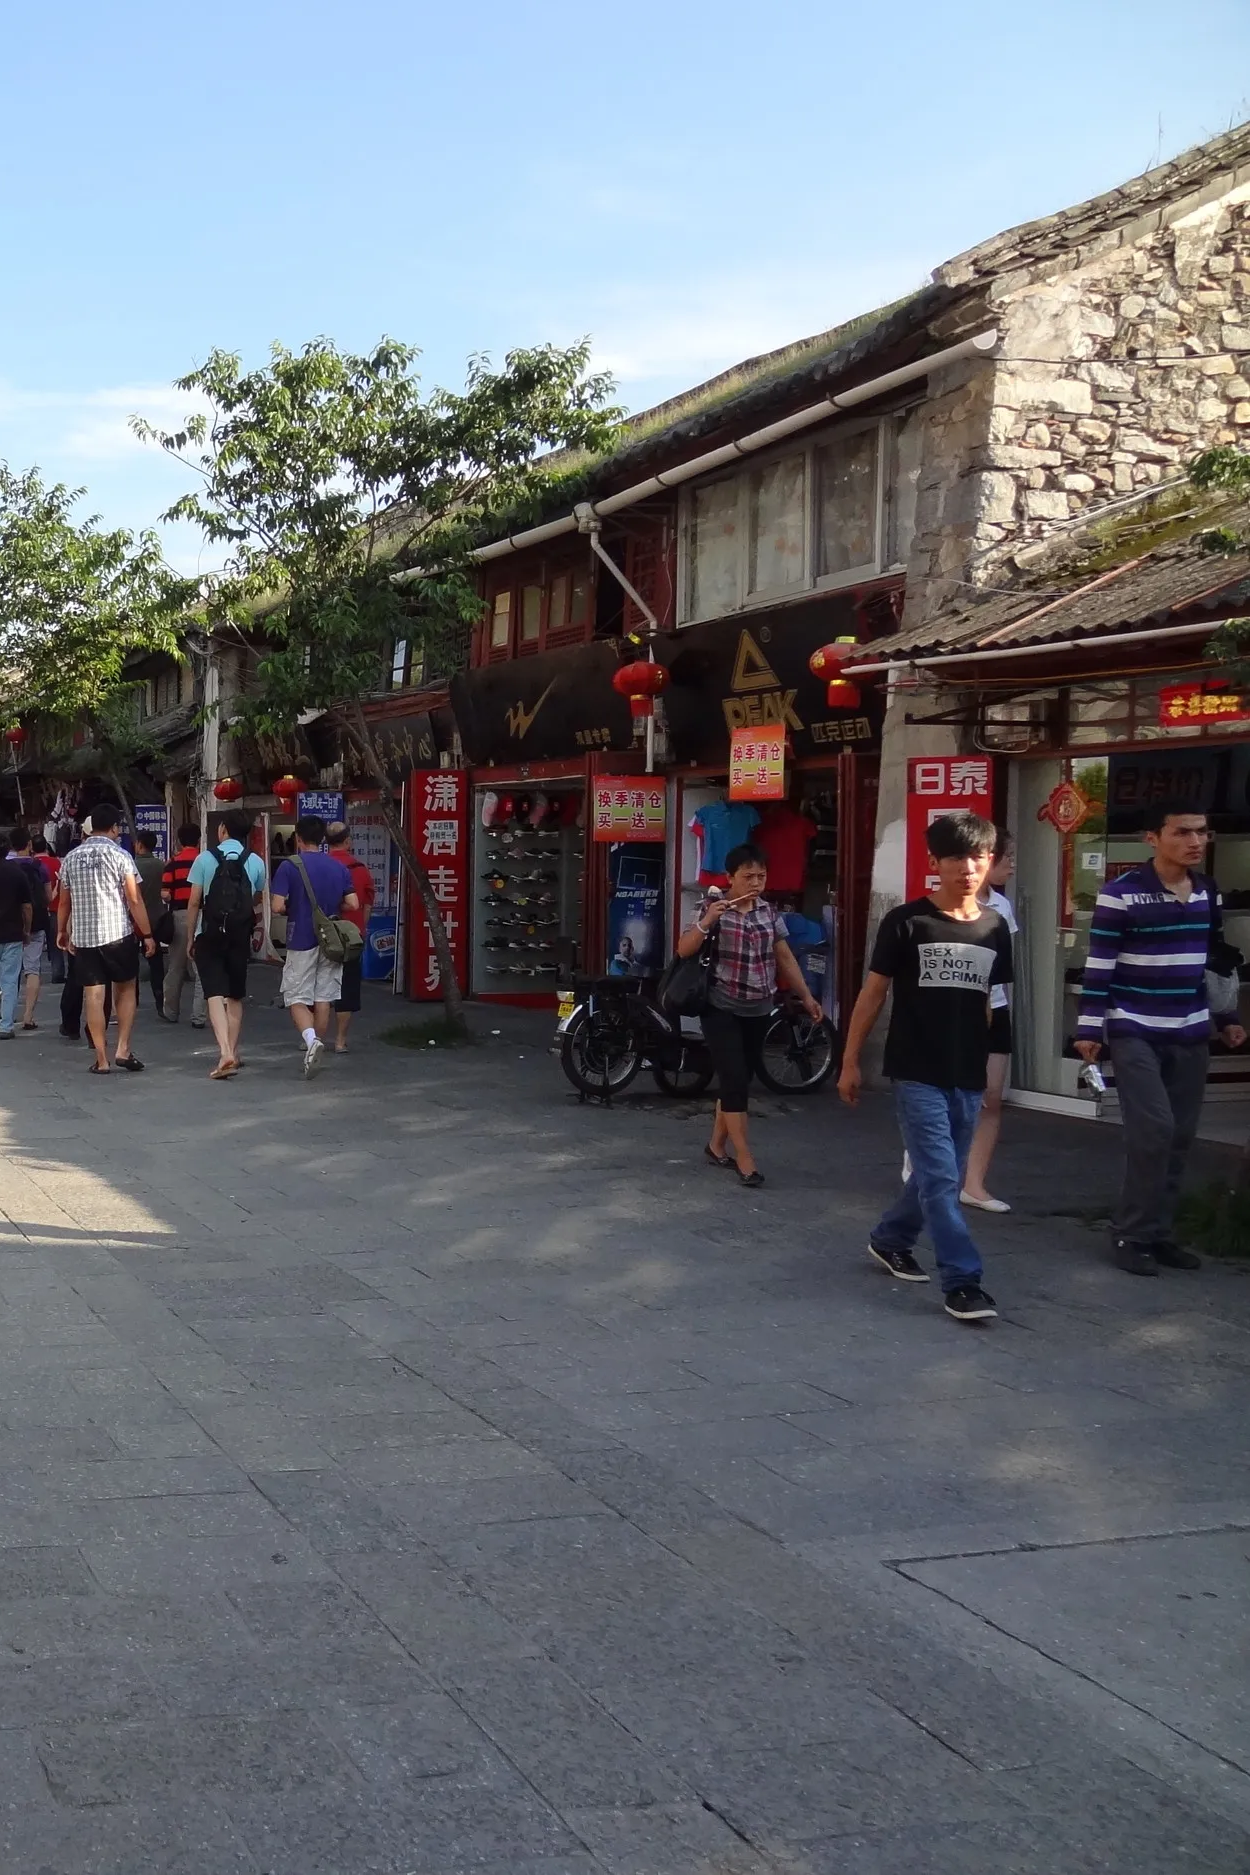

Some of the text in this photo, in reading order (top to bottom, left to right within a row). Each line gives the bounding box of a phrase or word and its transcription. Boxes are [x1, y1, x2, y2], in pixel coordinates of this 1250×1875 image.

[722, 689, 805, 737] PEAK
[811, 717, 872, 744] 匹克运动
[733, 743, 781, 764] 换季清仓
[732, 767, 781, 786] 买一送一
[915, 761, 988, 796] 日泰
[597, 791, 662, 809] 换季清仓
[597, 812, 663, 829] 买一送一
[923, 948, 954, 958] SEX
[923, 959, 973, 970] IS NOT
[921, 971, 934, 981] A
